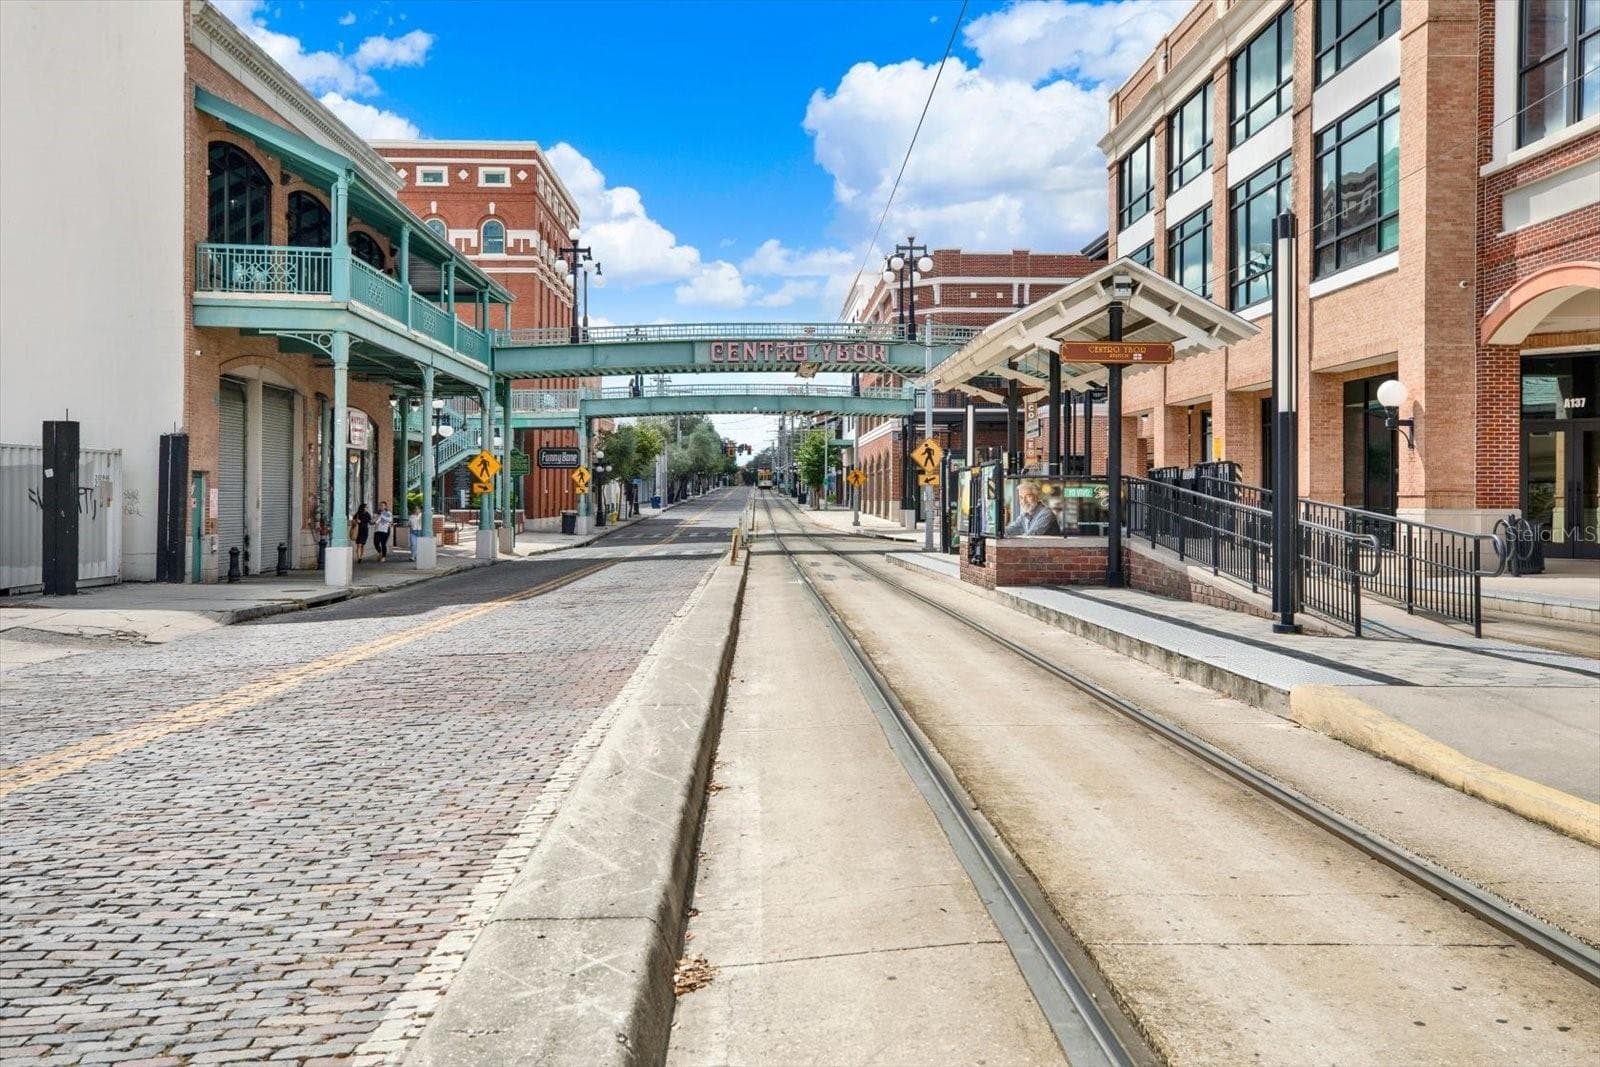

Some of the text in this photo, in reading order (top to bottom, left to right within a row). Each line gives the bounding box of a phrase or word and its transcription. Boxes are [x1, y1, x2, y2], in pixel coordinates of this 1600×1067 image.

[711, 341, 888, 363] CENTRO YBOR
[1088, 345, 1120, 353] CENTRO
[1564, 397, 1586, 409] A137
